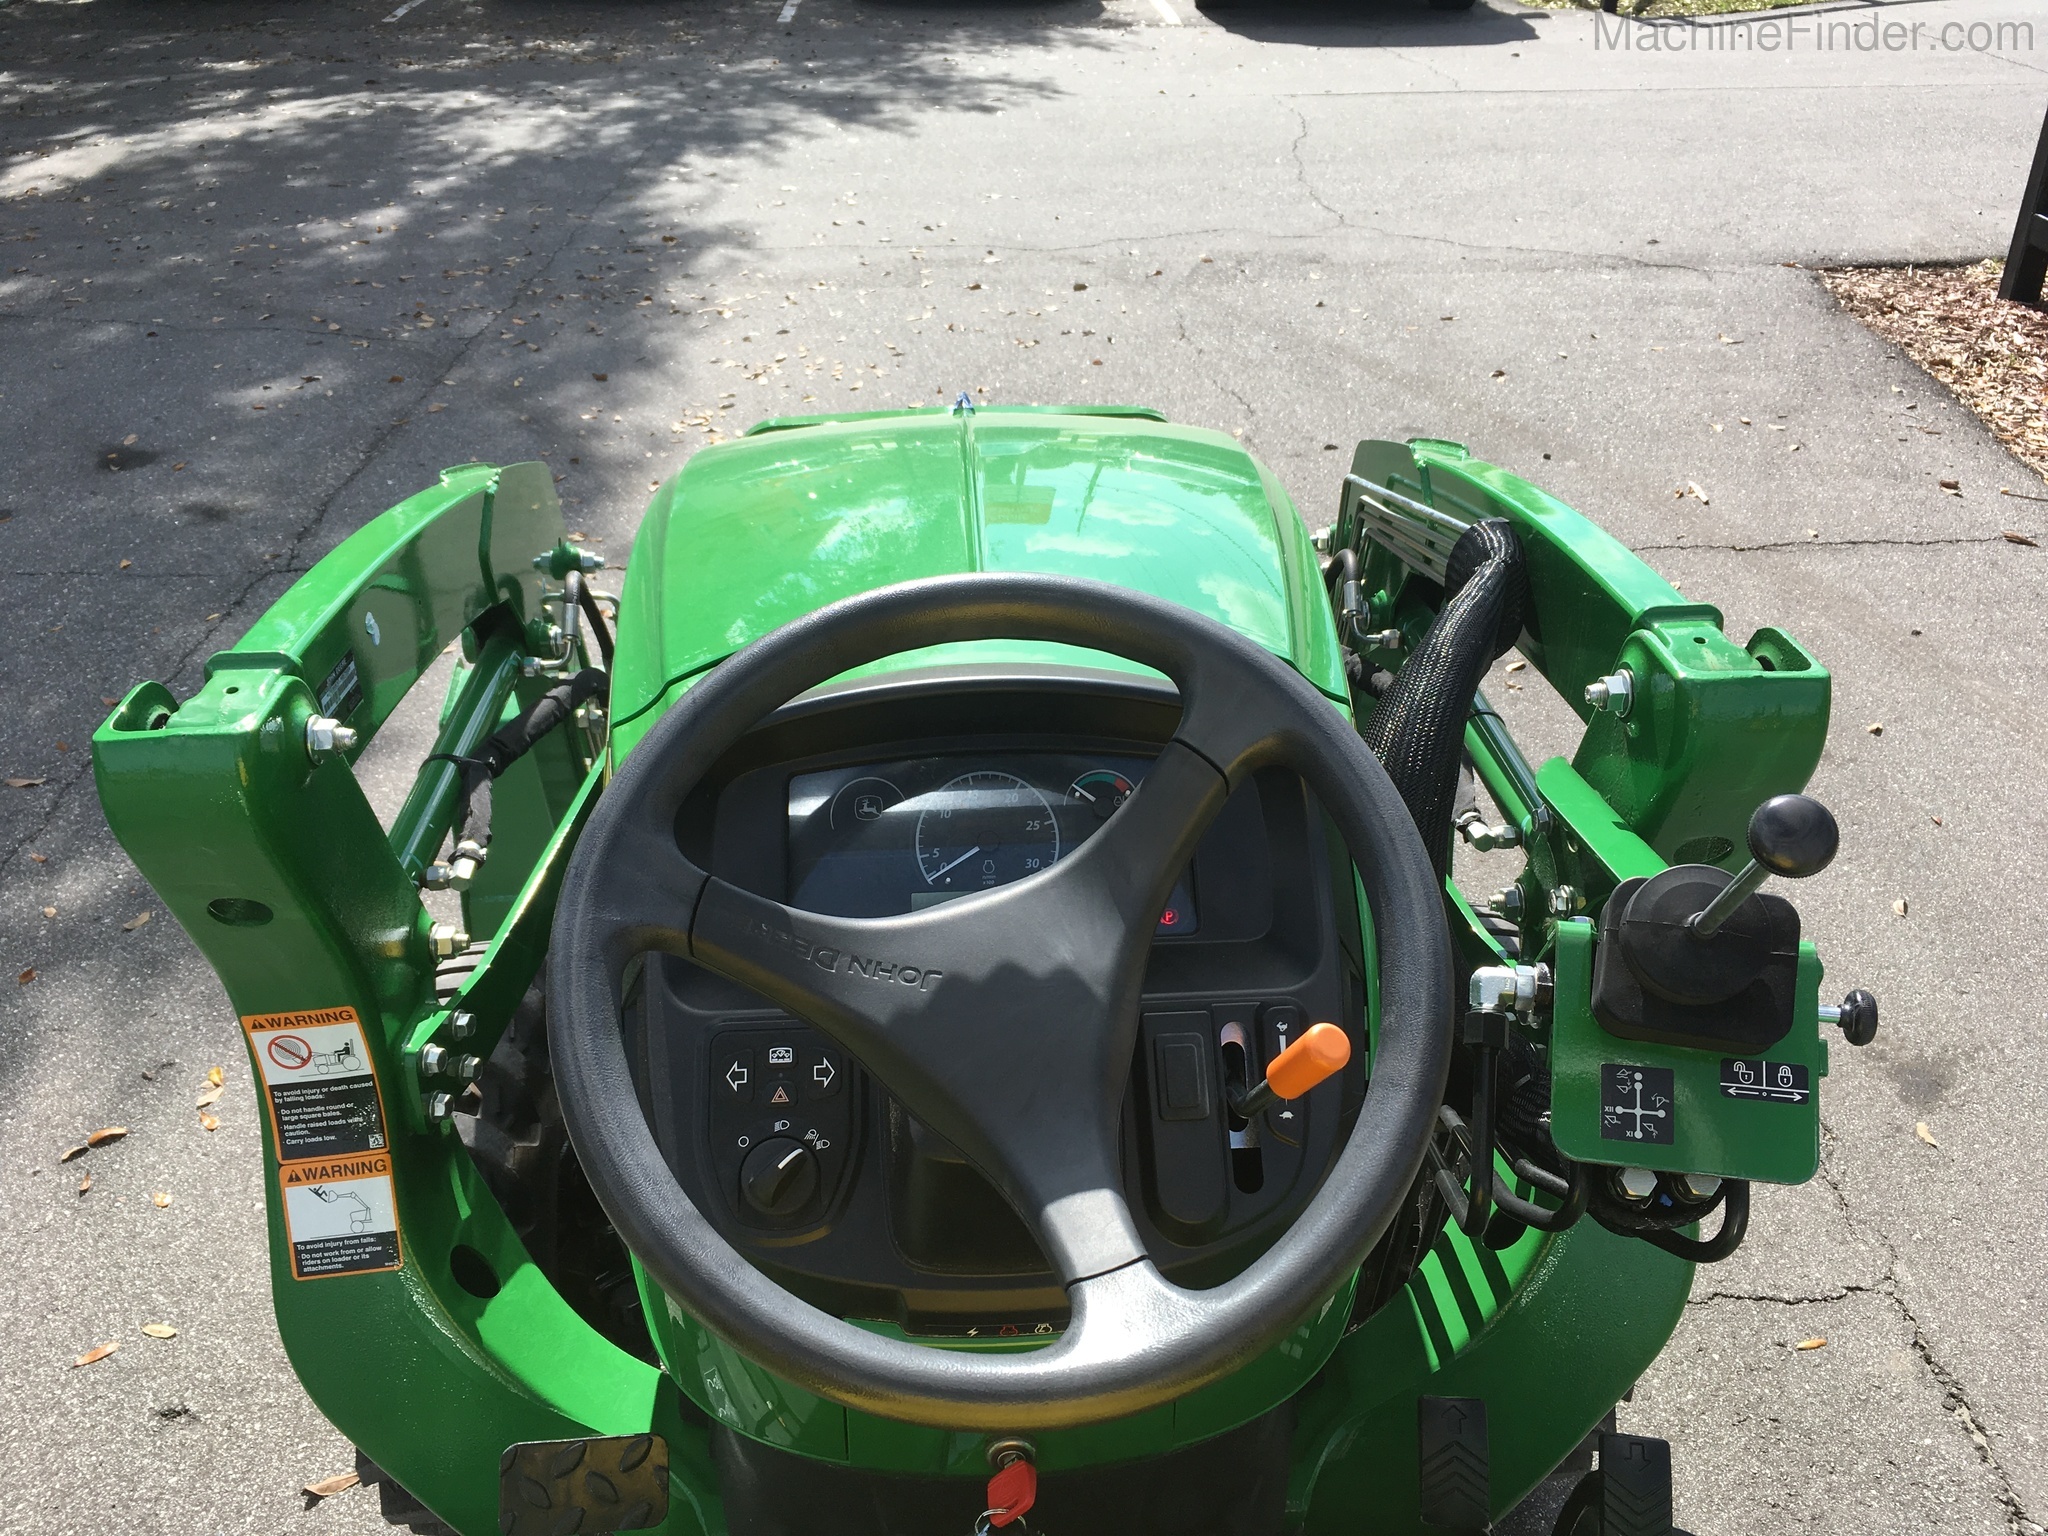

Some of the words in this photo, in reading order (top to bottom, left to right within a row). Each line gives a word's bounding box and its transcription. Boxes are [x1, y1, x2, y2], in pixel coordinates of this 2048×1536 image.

[1004, 793, 1018, 803] 20
[940, 809, 952, 818] 10
[1026, 820, 1040, 830] 25
[932, 848, 940, 858] 5
[1025, 858, 1040, 868] 30
[744, 919, 840, 973] DEE
[848, 954, 943, 991] JOHN
[264, 1010, 354, 1028] WARNING
[350, 1081, 373, 1089] caused
[302, 1159, 387, 1180] WARNING
[303, 1264, 344, 1272] attachments.
